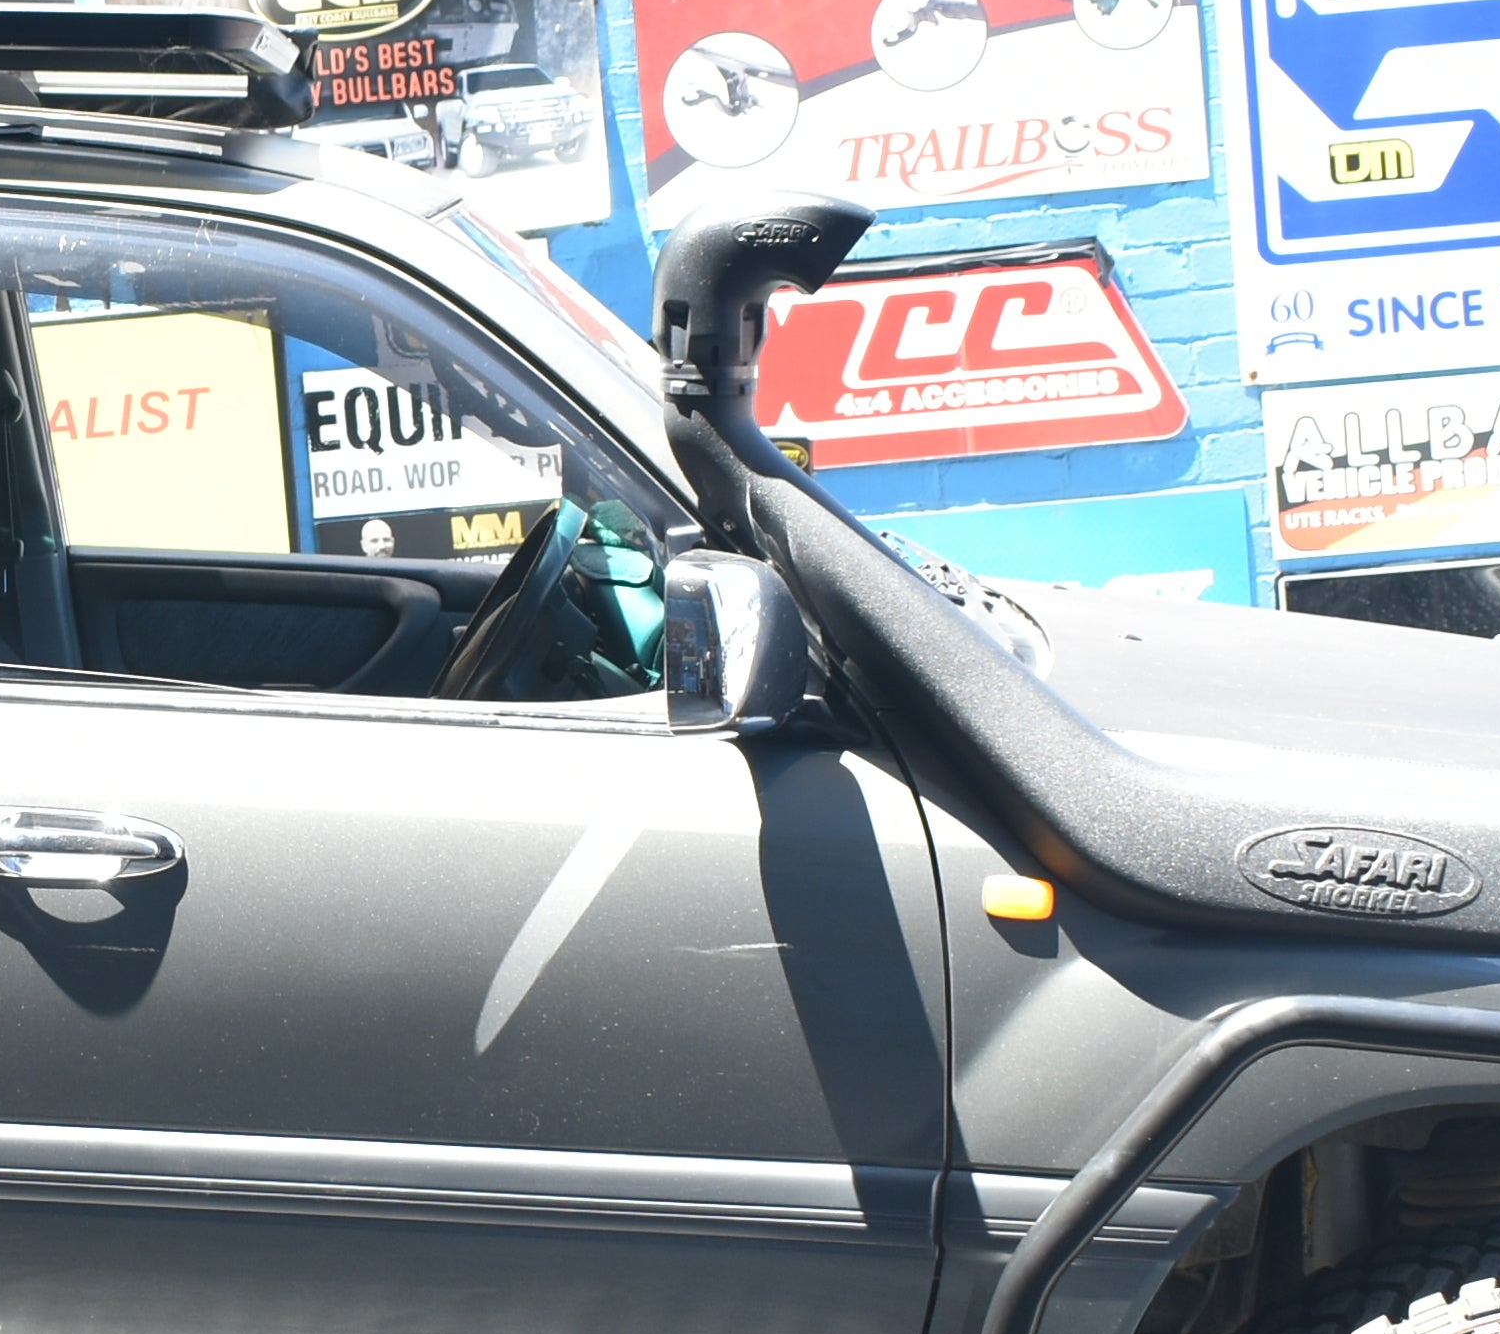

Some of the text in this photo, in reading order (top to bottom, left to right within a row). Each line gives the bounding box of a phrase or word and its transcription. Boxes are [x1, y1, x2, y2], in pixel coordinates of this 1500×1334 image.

[315, 39, 436, 76] LD'S BEST
[332, 67, 455, 107] BULLBARS
[1270, 289, 1314, 324] 60
[1347, 289, 1485, 338] SINCE
[834, 369, 1120, 418] 4x4 ACCESSORIES
[313, 460, 461, 499] ROAD. WOR
[1281, 461, 1416, 504] VEHICLE
[1285, 511, 1323, 530] UTE
[1268, 832, 1448, 893] SAFARI
[1300, 881, 1418, 914] SNORKEL
